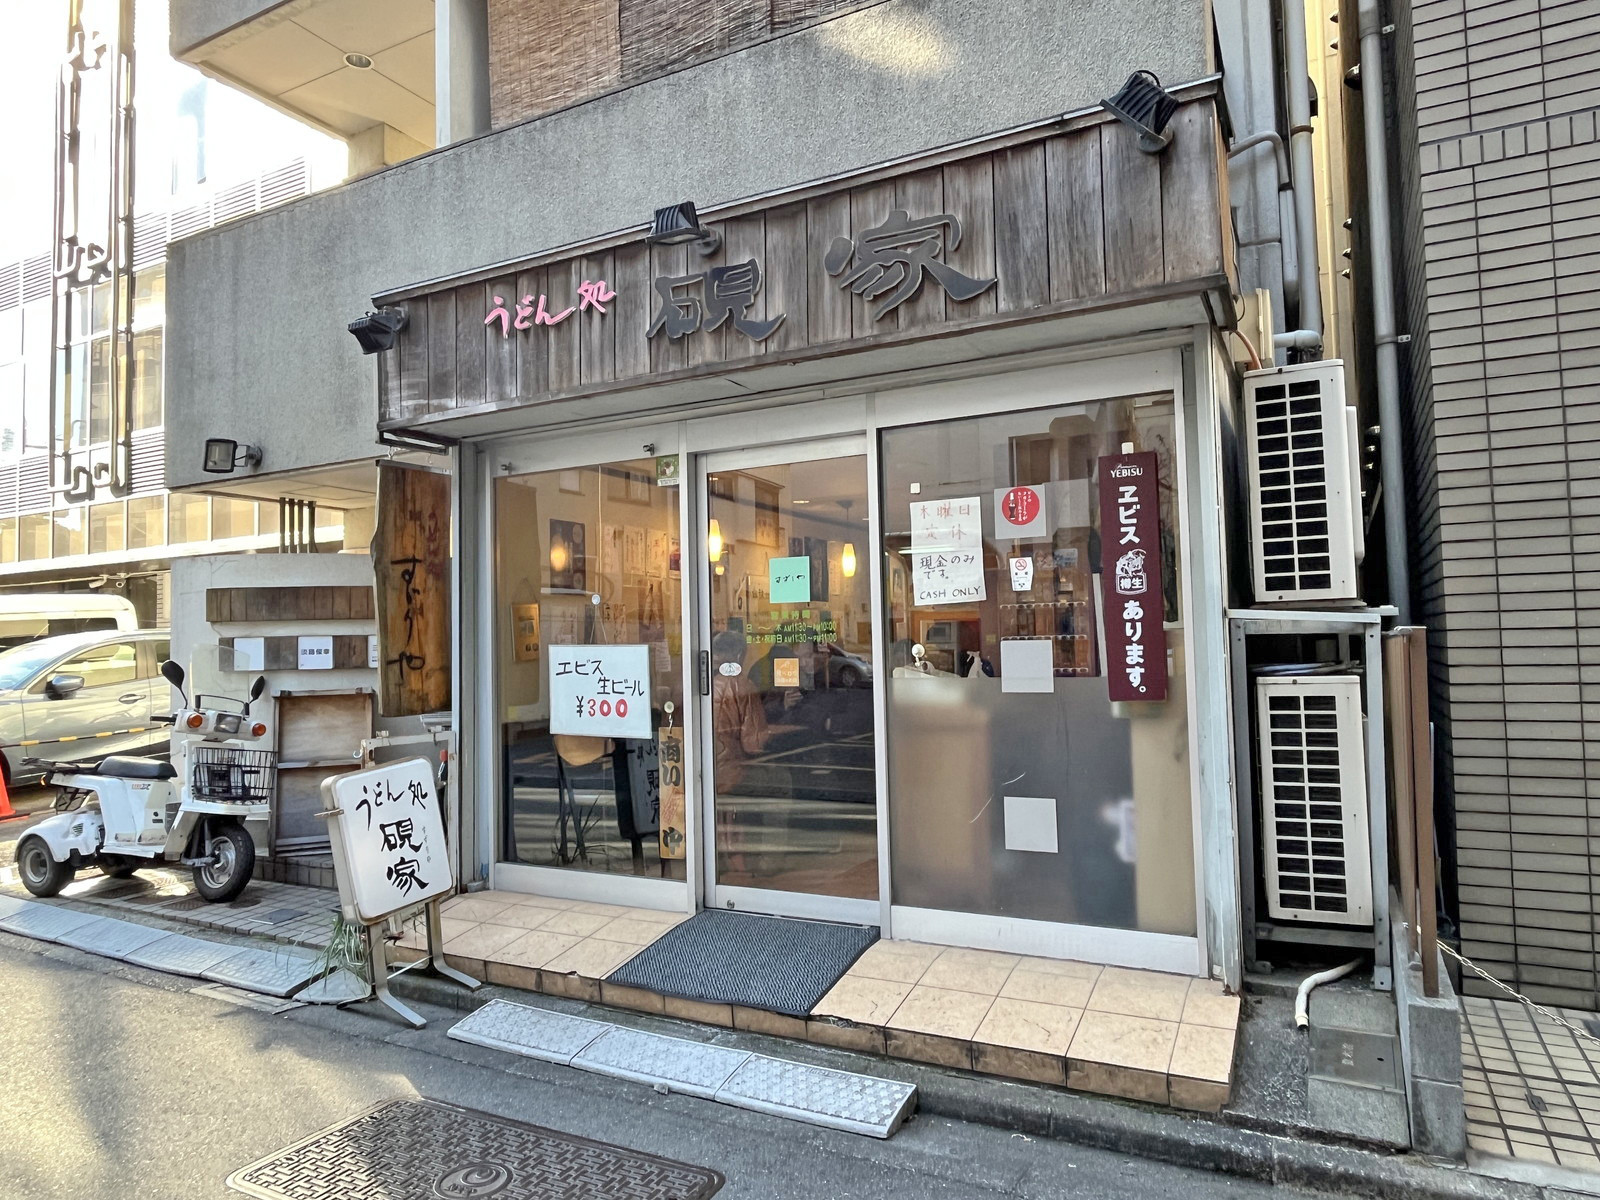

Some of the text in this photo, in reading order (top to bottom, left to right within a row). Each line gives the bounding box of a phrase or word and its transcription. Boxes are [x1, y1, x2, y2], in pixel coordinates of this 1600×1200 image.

[484, 279, 616, 338] うどん処
[1110, 467, 1143, 478] YEBISU
[920, 501, 970, 519] 木曜日
[926, 523, 967, 540] 定休
[920, 554, 975, 570] 現金のみ
[919, 585, 981, 600] CASH ONLY
[1122, 599, 1147, 693] あります。
[555, 659, 604, 676] エビス
[597, 676, 645, 697] 生ビール
[576, 695, 628, 718] ¥300
[355, 778, 429, 832] うどん処
